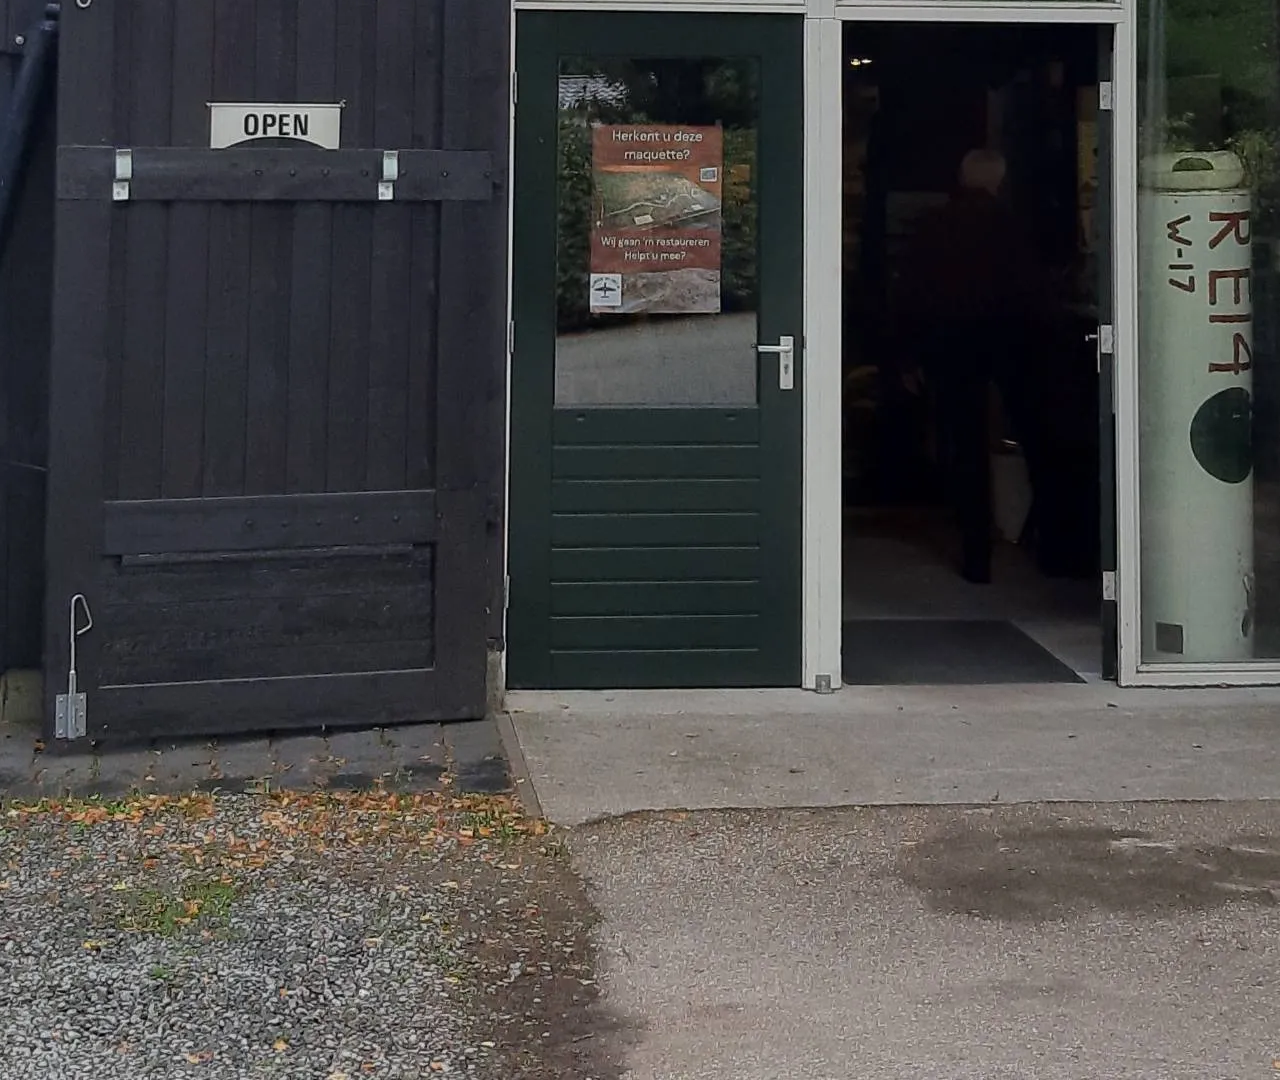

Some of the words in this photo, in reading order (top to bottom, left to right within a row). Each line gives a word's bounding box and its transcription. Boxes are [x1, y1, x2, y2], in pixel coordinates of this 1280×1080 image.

[243, 113, 309, 136] OPEN
[612, 130, 660, 143] Herkent
[663, 132, 671, 143] u
[673, 130, 703, 142] deze
[624, 149, 691, 162] maquette?
[601, 236, 616, 248] Wij
[618, 238, 641, 248] gaan
[656, 238, 710, 247] restaureren
[624, 251, 651, 262] Helpt
[652, 253, 658, 261] u
[661, 251, 686, 261] mee?
[1166, 214, 1196, 293] W-17
